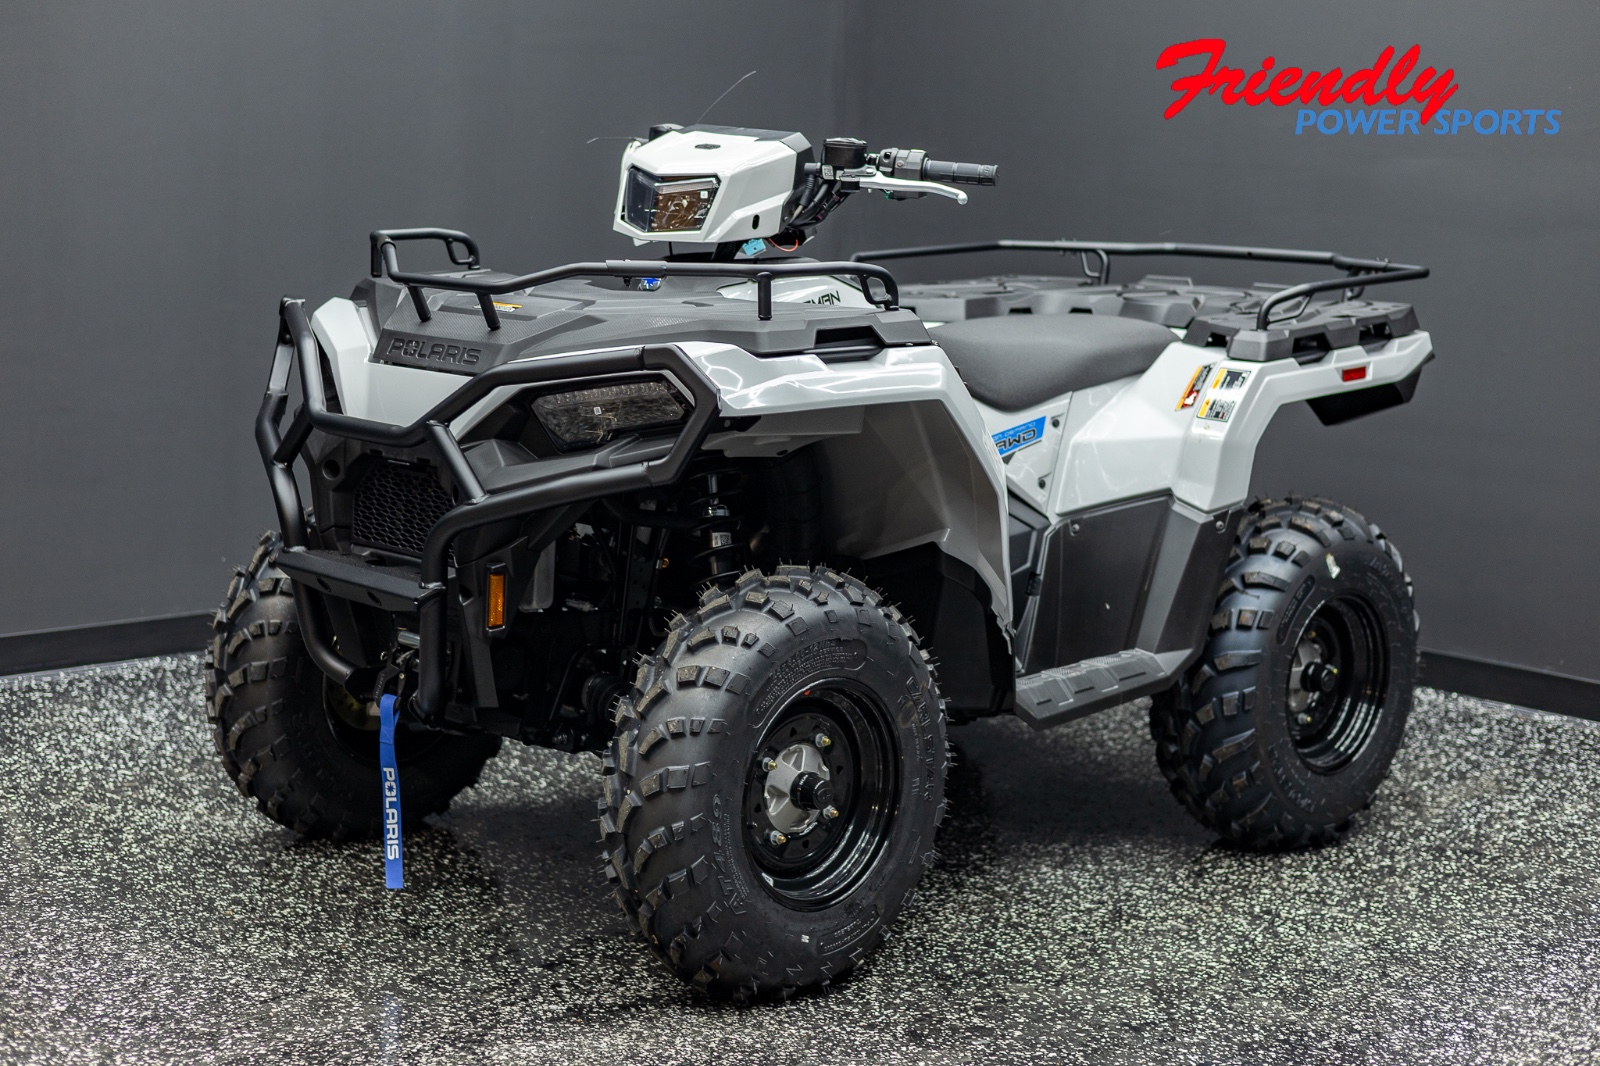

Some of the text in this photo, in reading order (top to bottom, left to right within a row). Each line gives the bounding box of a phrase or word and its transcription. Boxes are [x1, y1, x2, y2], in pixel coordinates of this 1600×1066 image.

[803, 290, 841, 305] MAN
[387, 338, 482, 366] POLARIS
[995, 428, 1036, 450] AWD
[382, 767, 400, 861] POLARIS
